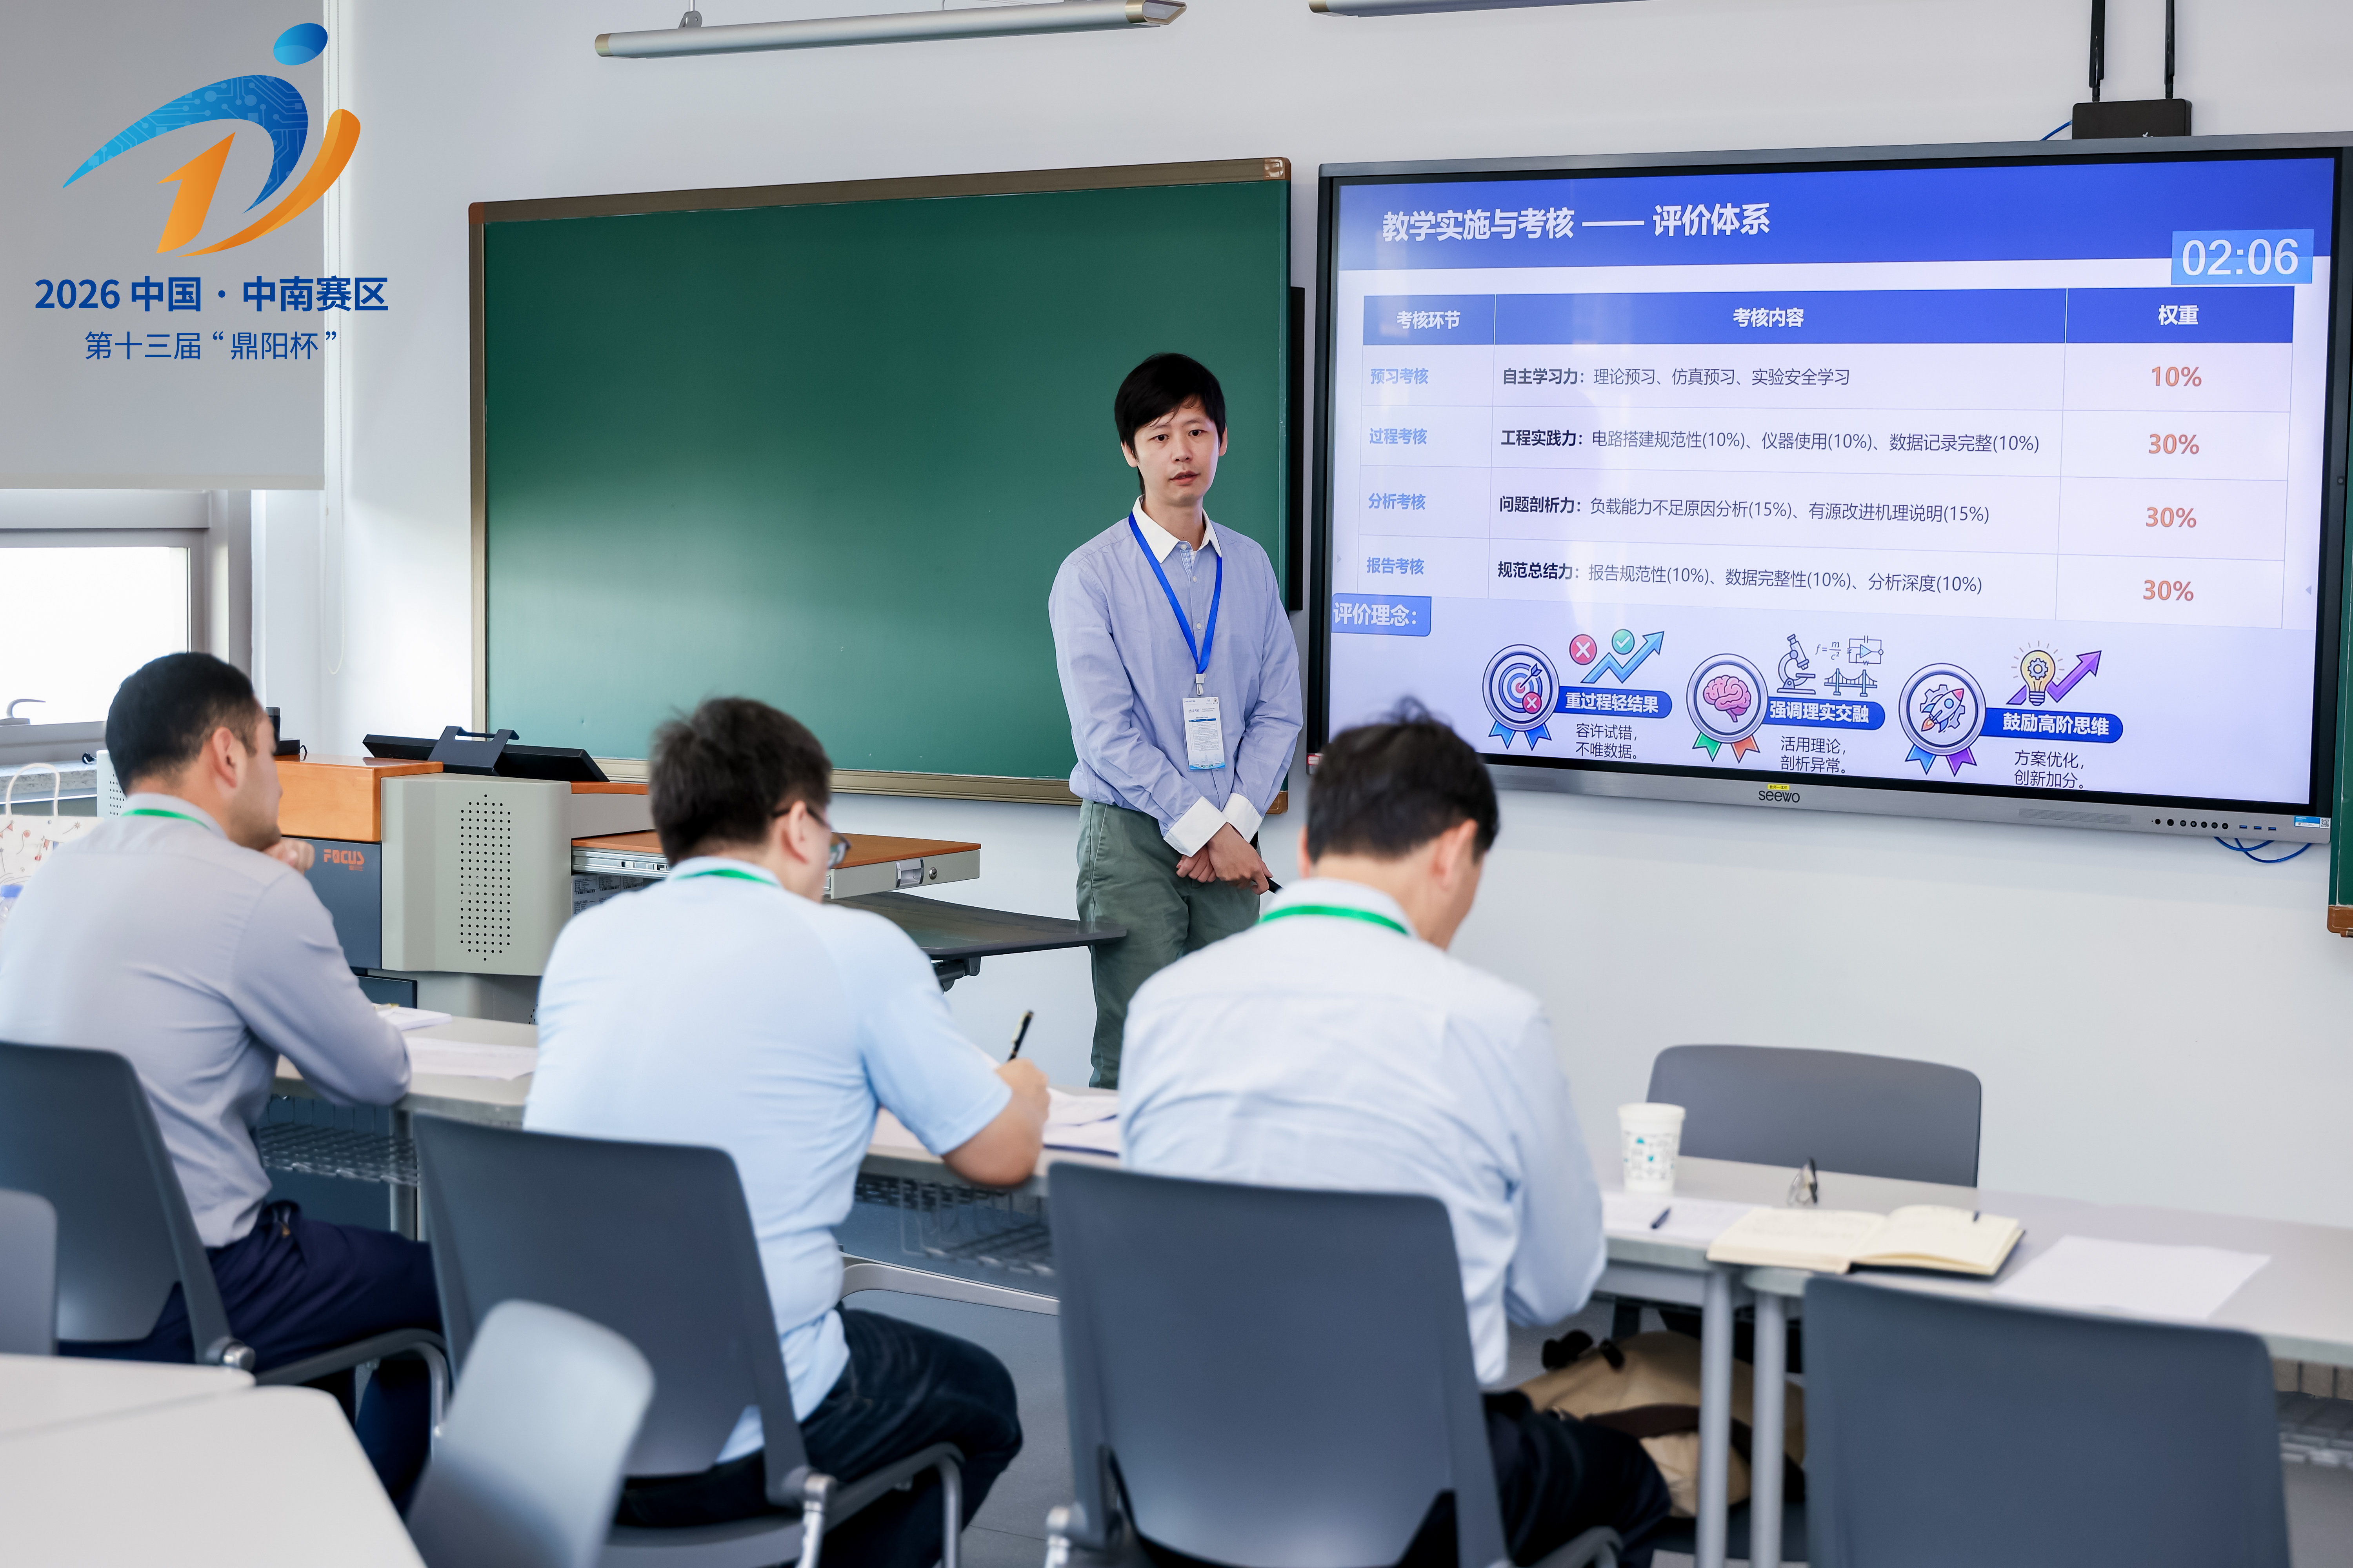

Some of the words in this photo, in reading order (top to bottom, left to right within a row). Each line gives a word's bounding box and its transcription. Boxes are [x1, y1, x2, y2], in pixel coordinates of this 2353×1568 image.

[1382, 208, 1575, 242] 教学实施与考核
[1653, 203, 1769, 236] 评价体系
[2182, 238, 2298, 276] 02:06
[1397, 309, 1462, 330] 考核环节
[1733, 307, 1804, 327] 考核内容
[2158, 305, 2198, 325] 权重
[1371, 368, 1428, 384] 预习考核
[2152, 366, 2202, 387] 10%
[1370, 428, 1427, 445] 过程考核
[2149, 434, 2199, 454] 30%
[1369, 493, 1426, 510] 分析考核
[2146, 507, 2196, 528] 30%
[1367, 557, 1424, 575] 报告考核
[2143, 580, 2193, 601] 30%
[1333, 602, 1417, 626] 评价理念：
[1565, 693, 1658, 714] 重过程轻结果
[1770, 701, 1869, 723] 强调理实交融
[2002, 712, 2109, 737] 鼓励高阶思维
[1576, 741, 1637, 759] 不唯数据。
[1781, 755, 1847, 775] 剖析异常。
[2014, 770, 2084, 790] 创新加分。
[1758, 790, 1800, 803] seewo
[324, 849, 364, 865] FOCUS
